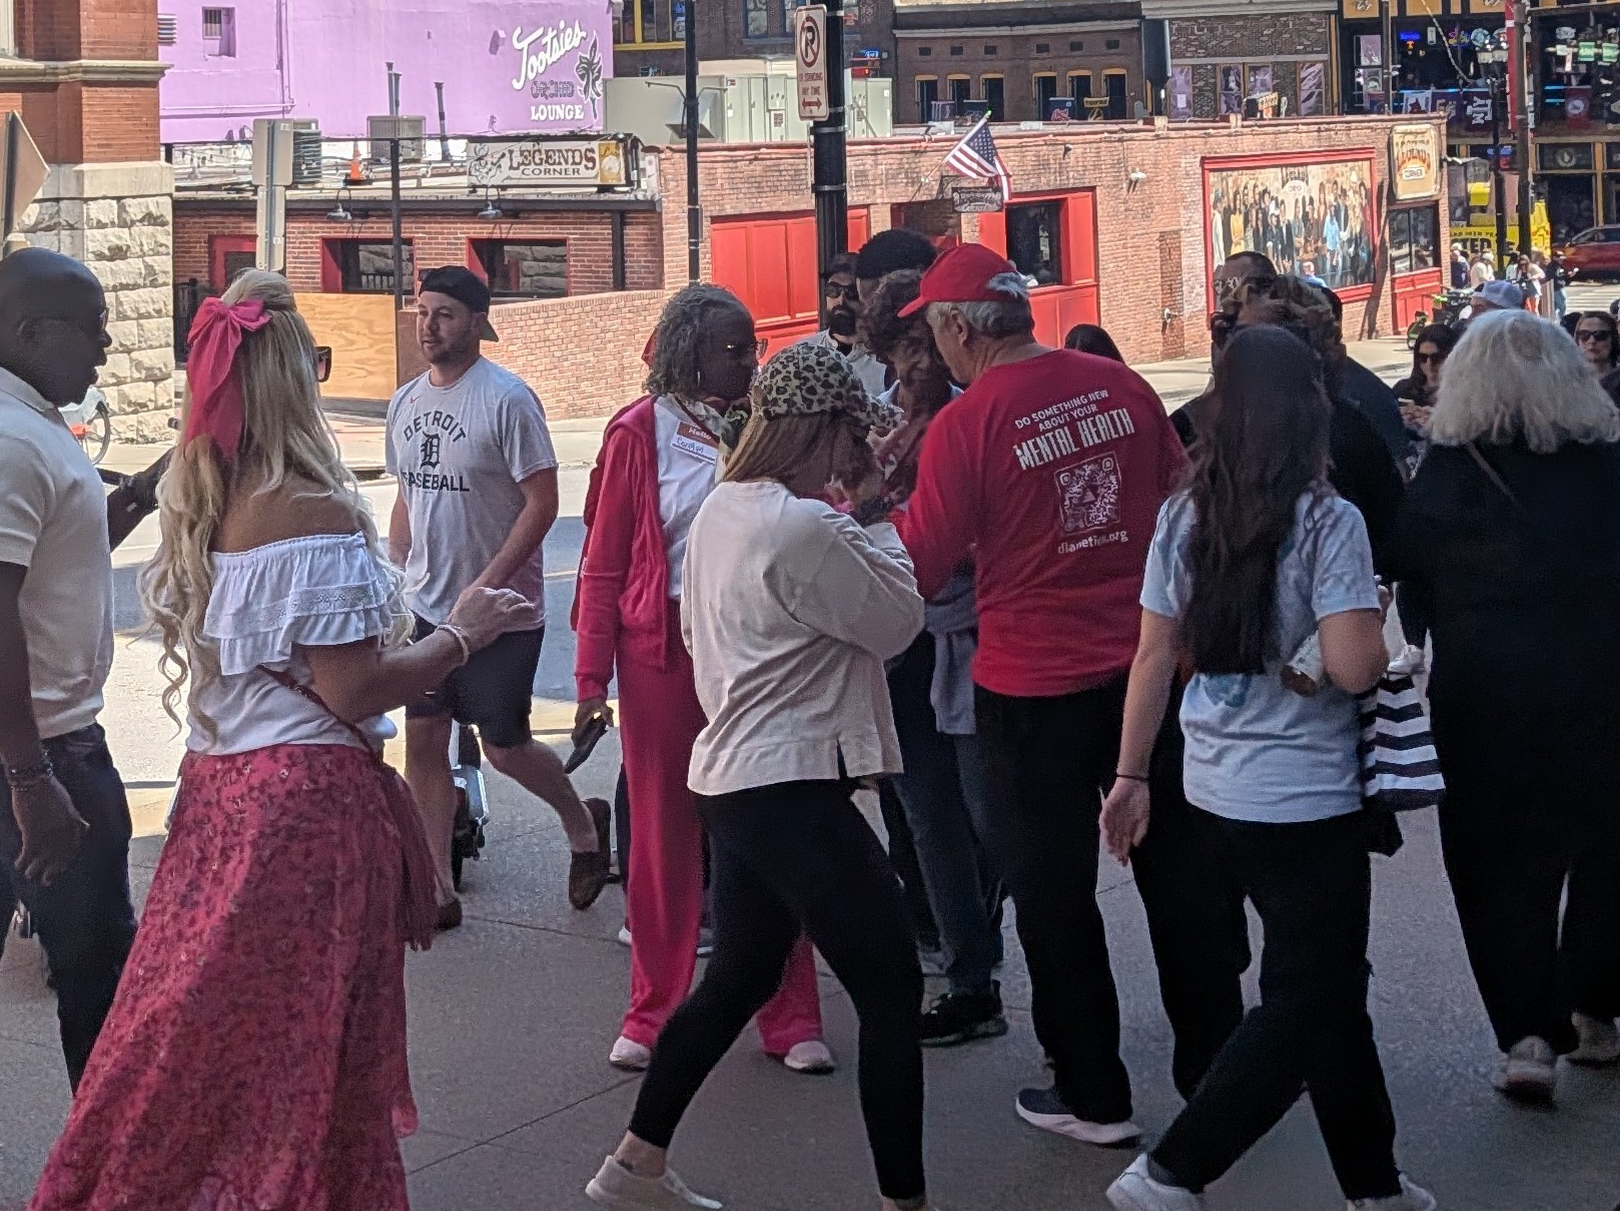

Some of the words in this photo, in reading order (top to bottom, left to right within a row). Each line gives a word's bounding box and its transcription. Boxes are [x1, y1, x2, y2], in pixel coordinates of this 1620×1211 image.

[512, 20, 587, 90] Tootsies
[530, 80, 575, 100] ORCHID
[530, 104, 585, 120] LOUNGE
[507, 146, 597, 171] LEGENDS
[521, 167, 581, 176] CORNER
[1015, 417, 1031, 430] DO
[1031, 395, 1088, 423] SOMETHING
[1088, 390, 1109, 404] NEW
[1038, 413, 1071, 432] ABOUT
[1071, 403, 1099, 419] YOUR
[403, 410, 467, 443] DETROIT
[1013, 426, 1080, 471] MENTAL
[1076, 407, 1135, 448] HEALTH
